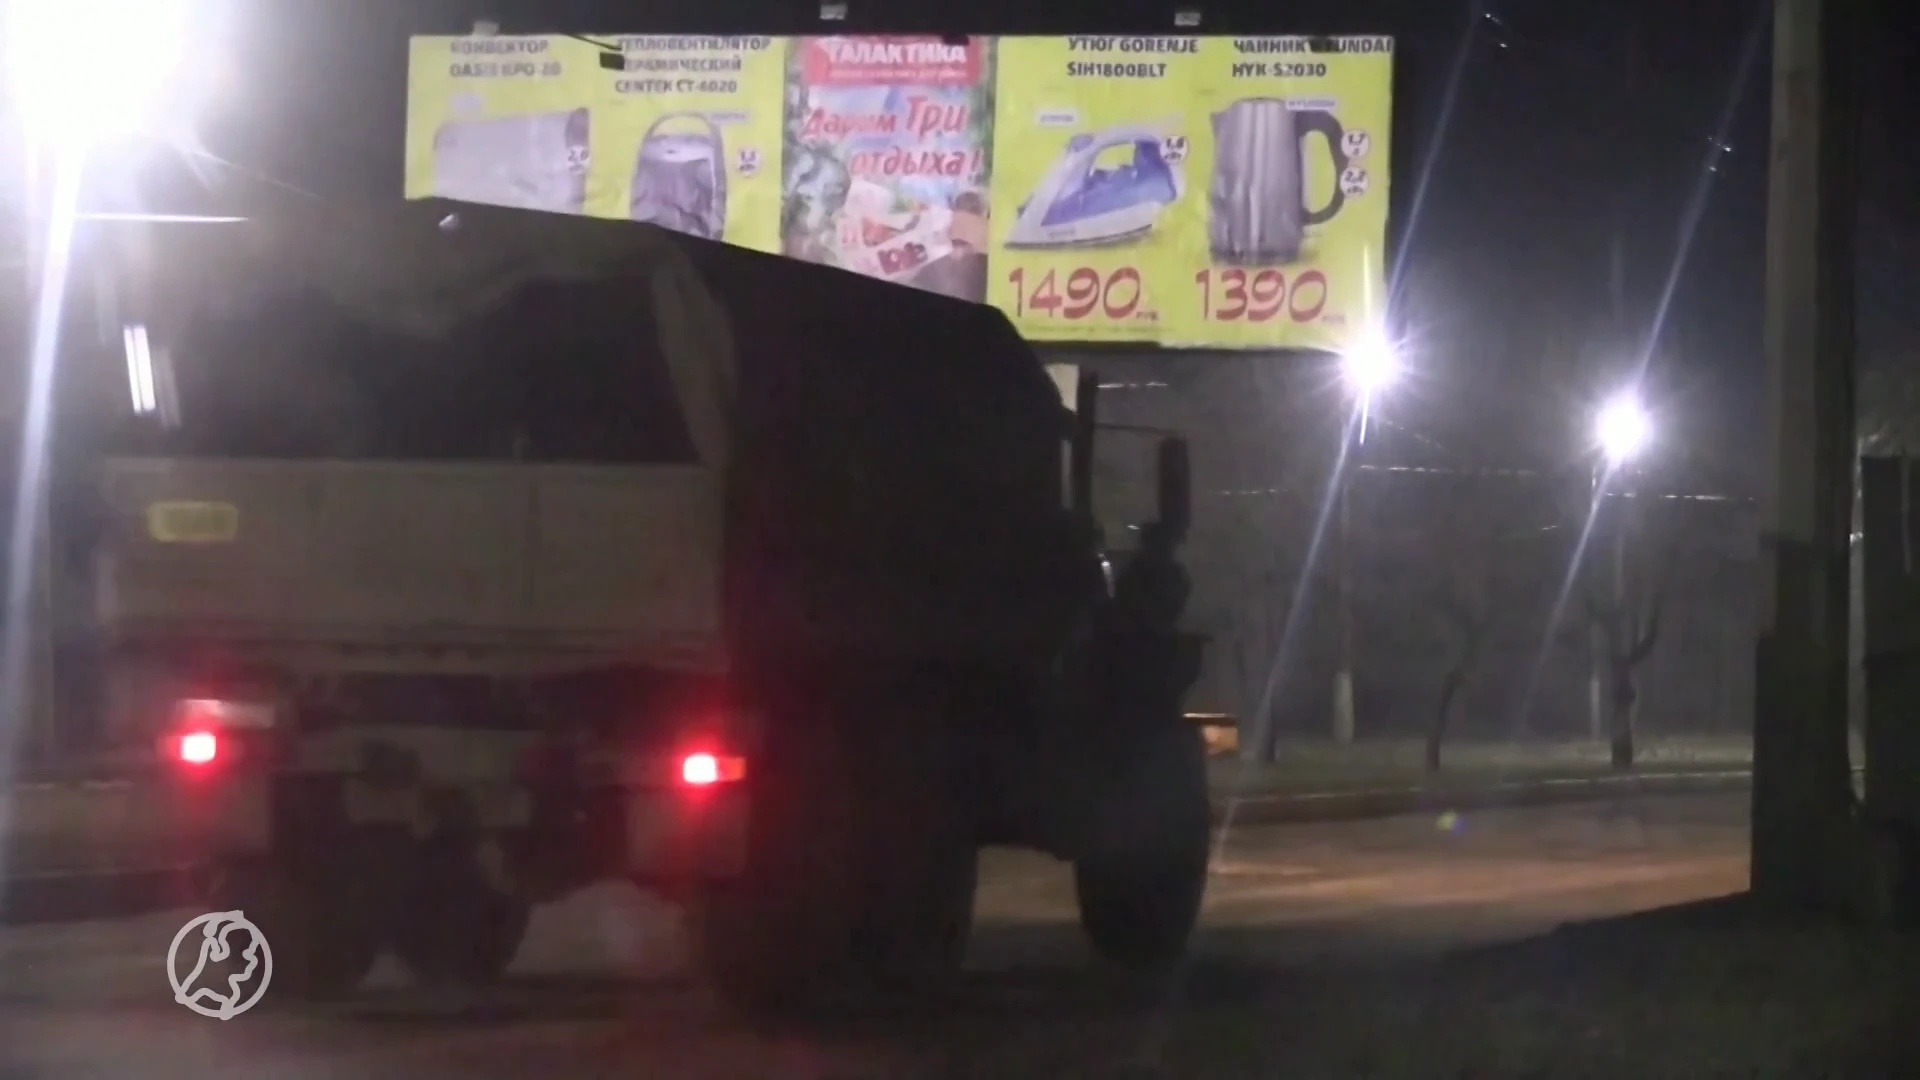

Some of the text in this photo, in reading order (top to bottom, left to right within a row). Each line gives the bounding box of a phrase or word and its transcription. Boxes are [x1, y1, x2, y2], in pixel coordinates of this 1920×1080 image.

[1067, 37, 1199, 54] УТЮГ GORENJE
[624, 54, 742, 71] ЕРАМИЧЕСКИЙ
[1066, 60, 1167, 78] SIH1800BLT
[615, 79, 672, 93] CENTEK
[906, 96, 967, 144] Три
[1008, 267, 1141, 320] 1490
[1195, 269, 1328, 323] 1390
